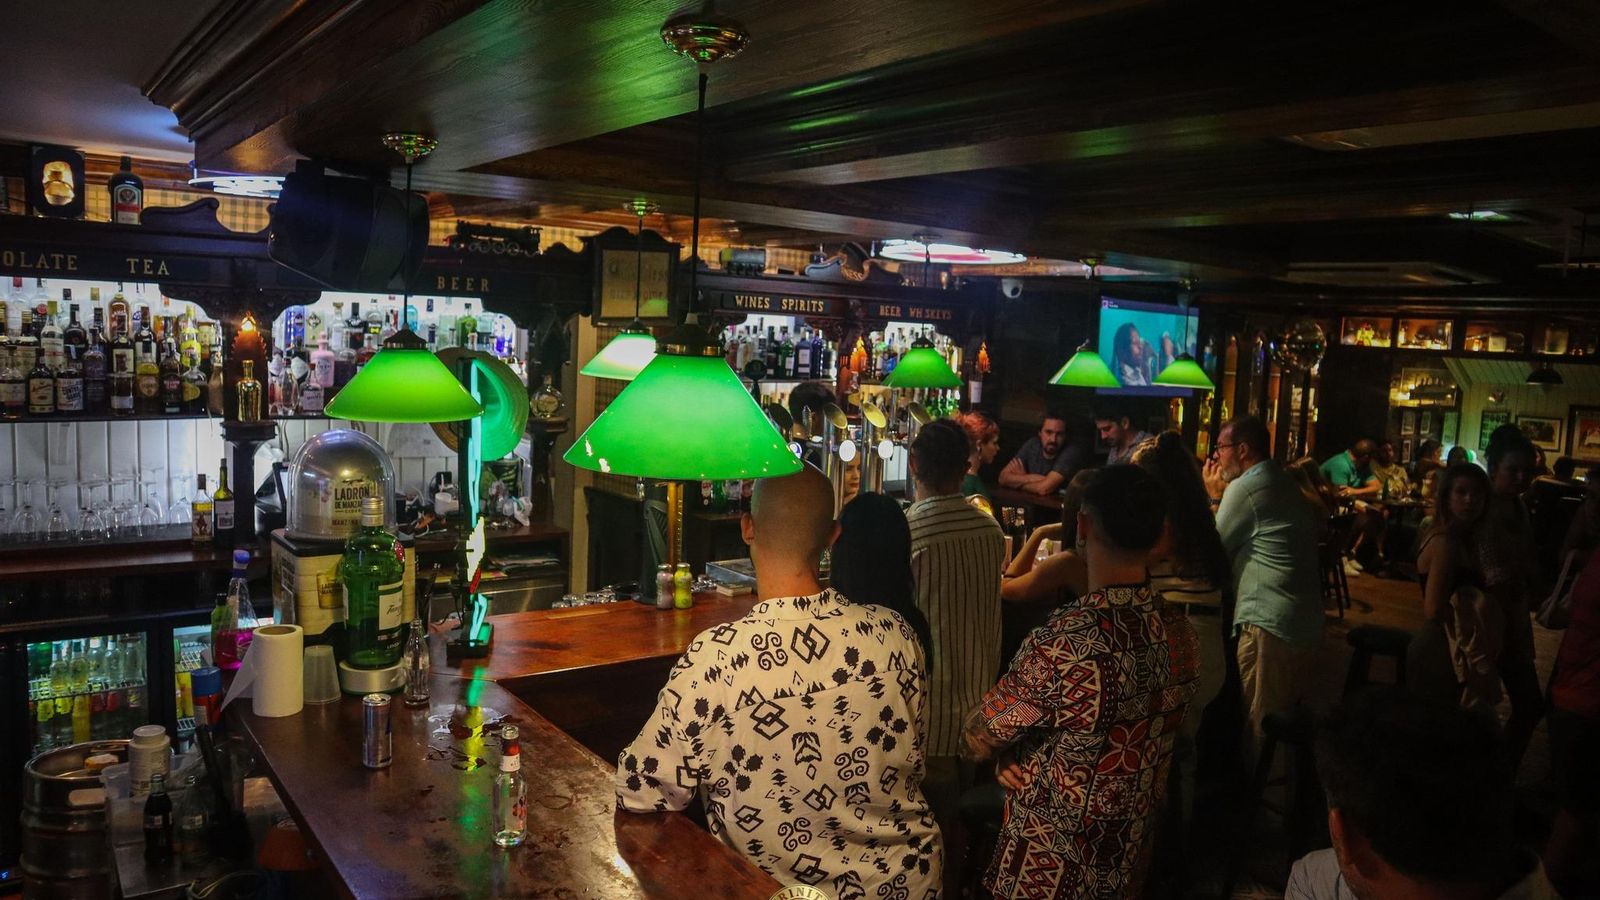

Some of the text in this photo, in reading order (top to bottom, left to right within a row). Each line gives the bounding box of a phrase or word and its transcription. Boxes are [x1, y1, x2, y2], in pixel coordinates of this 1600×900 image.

[3, 250, 78, 271] OLATE
[126, 257, 170, 276] TEA
[437, 275, 490, 292] BEER
[735, 295, 824, 312] WINES SPIRITS
[880, 304, 952, 320] BEER WHSKEYS
